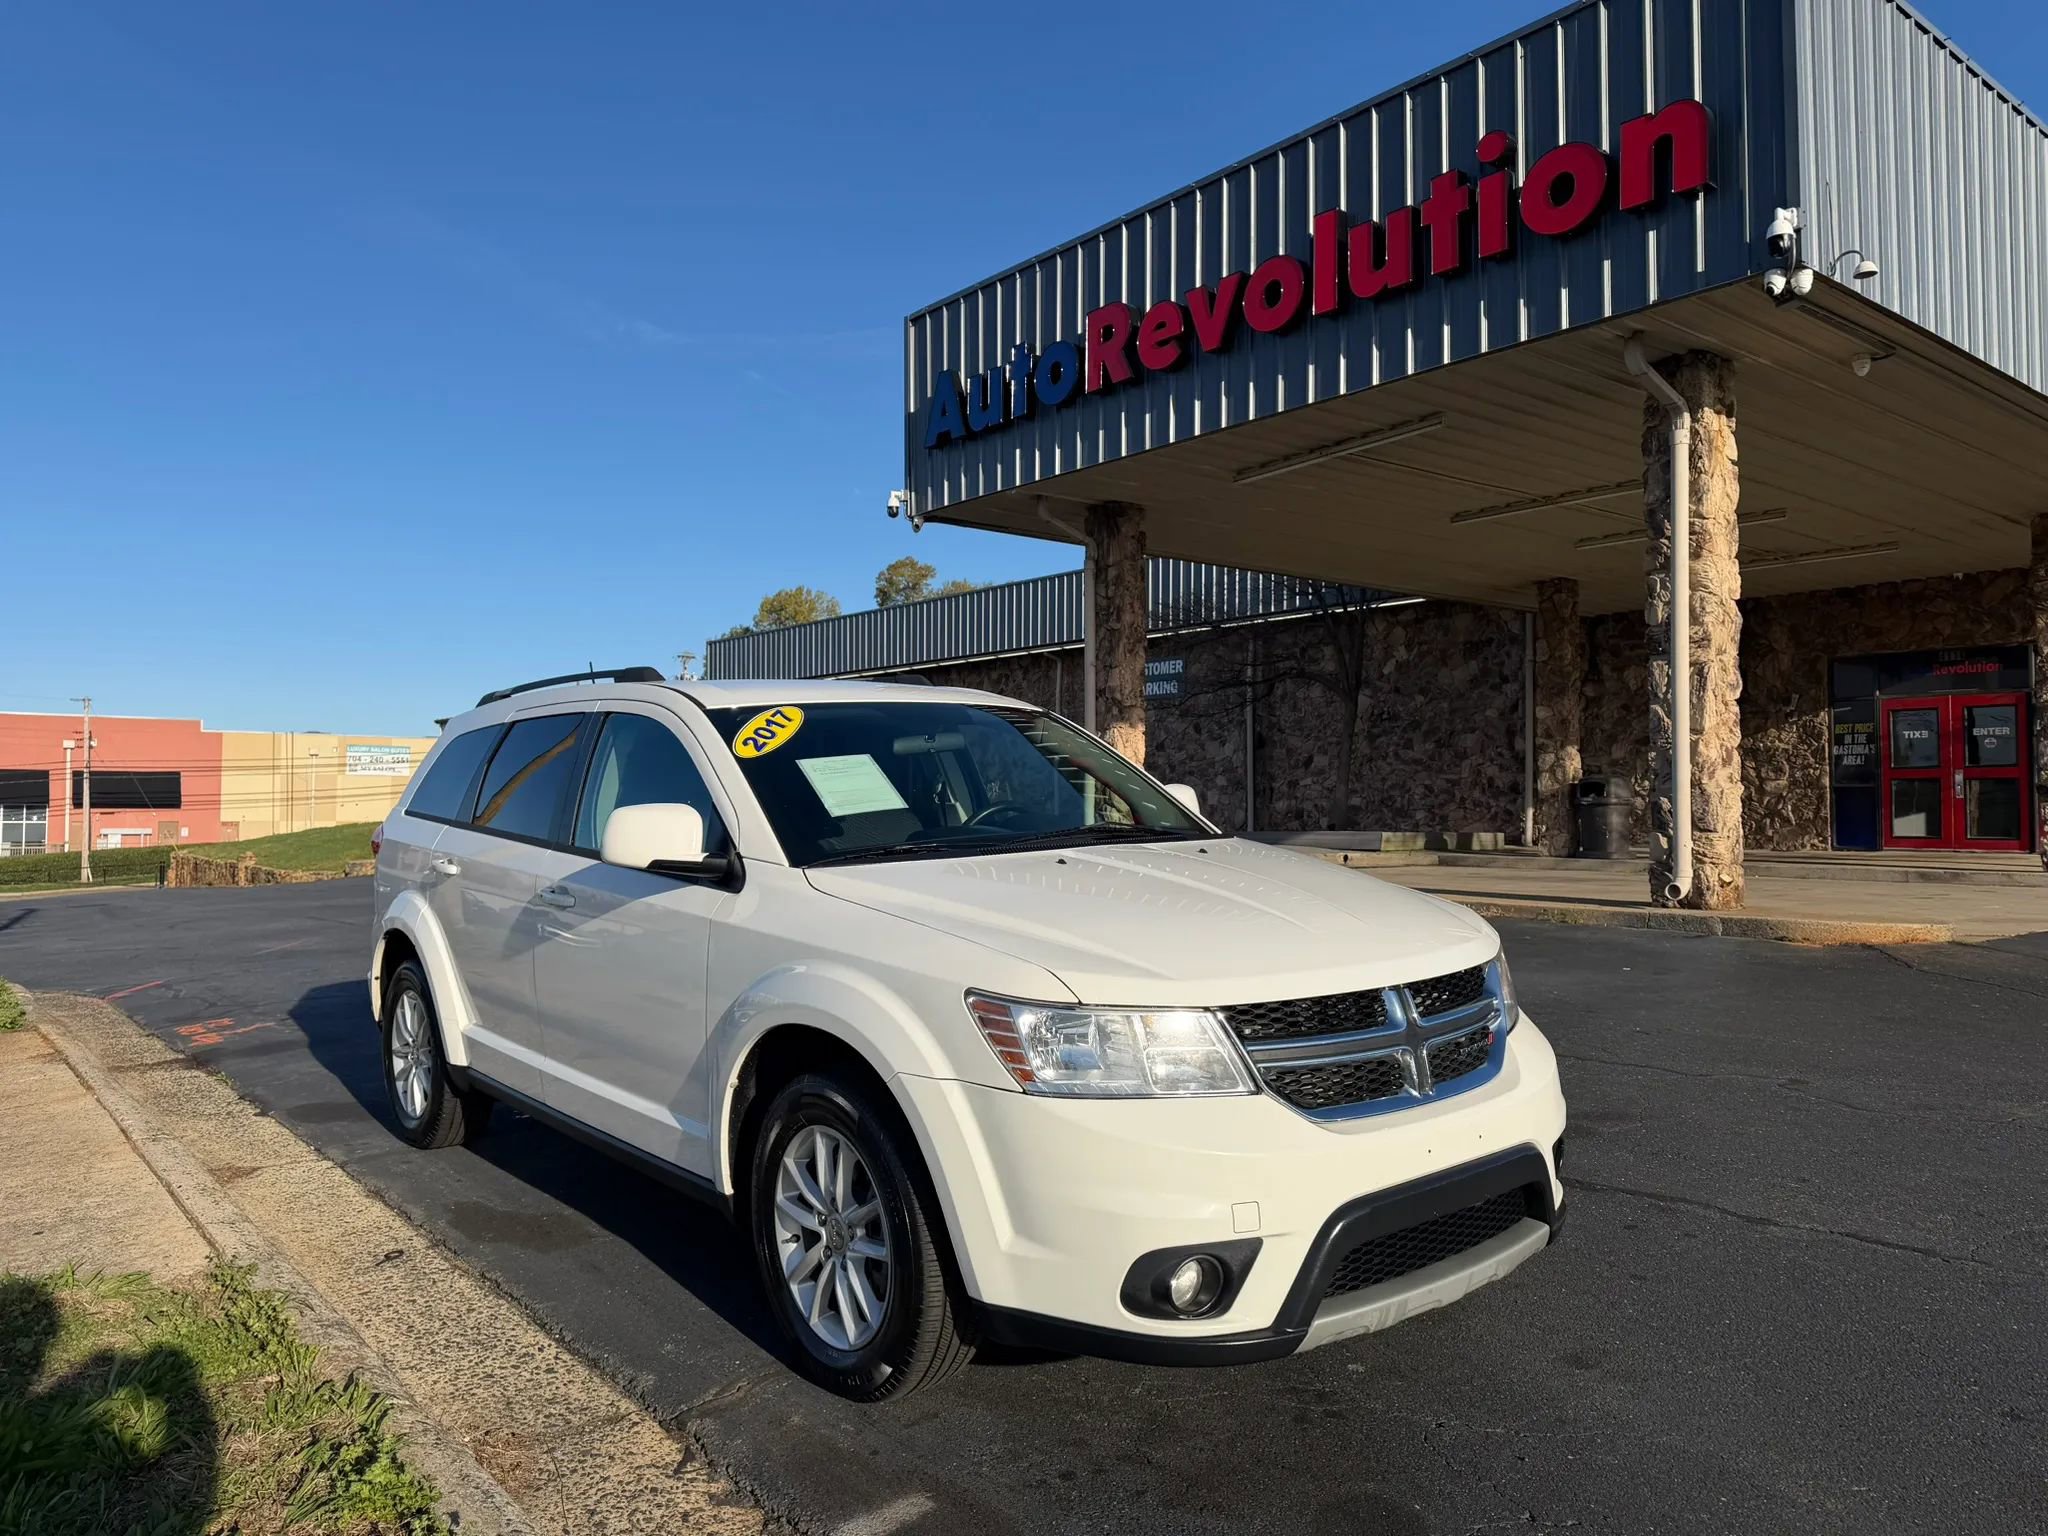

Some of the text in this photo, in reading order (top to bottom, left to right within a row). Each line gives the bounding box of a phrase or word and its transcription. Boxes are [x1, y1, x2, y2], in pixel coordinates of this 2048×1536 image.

[1144, 660, 1183, 676] STOMER
[1143, 680, 1178, 696] RKING
[742, 709, 793, 752] 2017
[1973, 727, 2010, 736] ENTER
